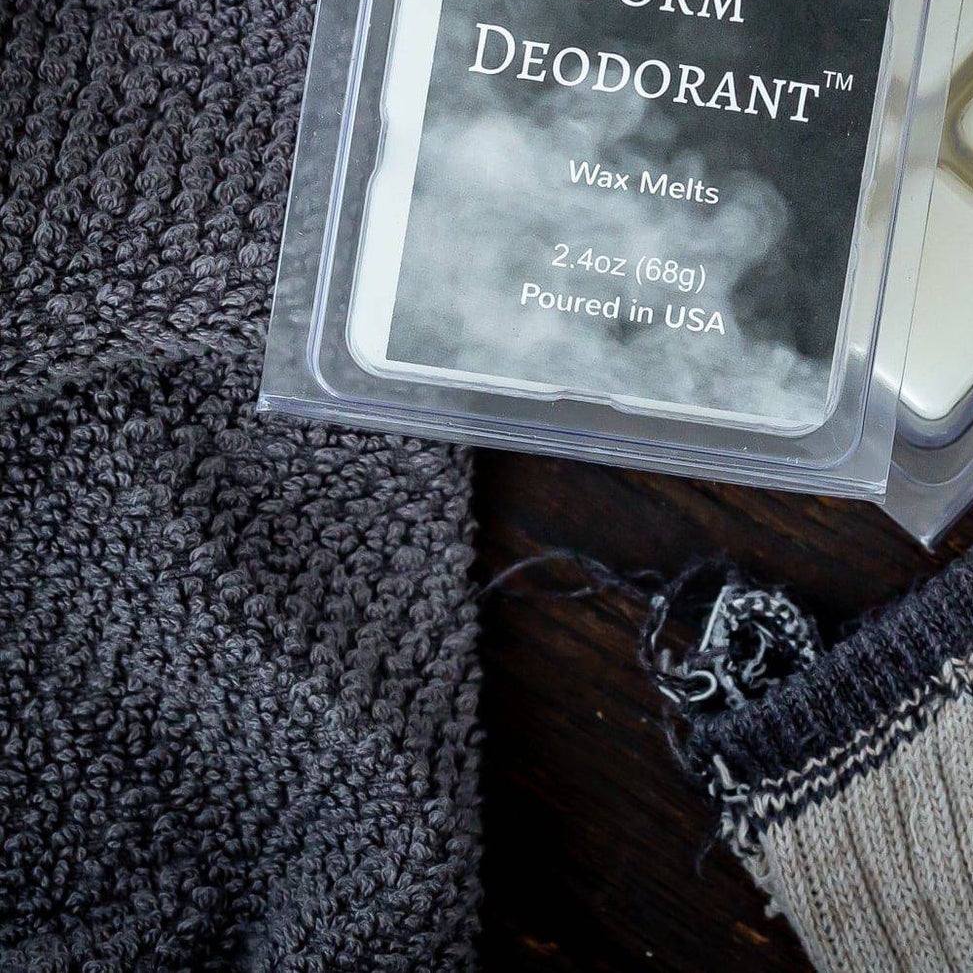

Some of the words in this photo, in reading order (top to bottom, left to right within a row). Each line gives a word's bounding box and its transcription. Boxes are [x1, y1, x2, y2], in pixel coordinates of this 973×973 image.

[568, 160, 628, 191] Wax
[640, 170, 720, 205] Melts
[551, 243, 626, 277] 2.4oz
[635, 256, 706, 293] (68g)
[520, 283, 620, 319] Poured
[629, 298, 653, 324] in
[664, 304, 726, 335] USA
